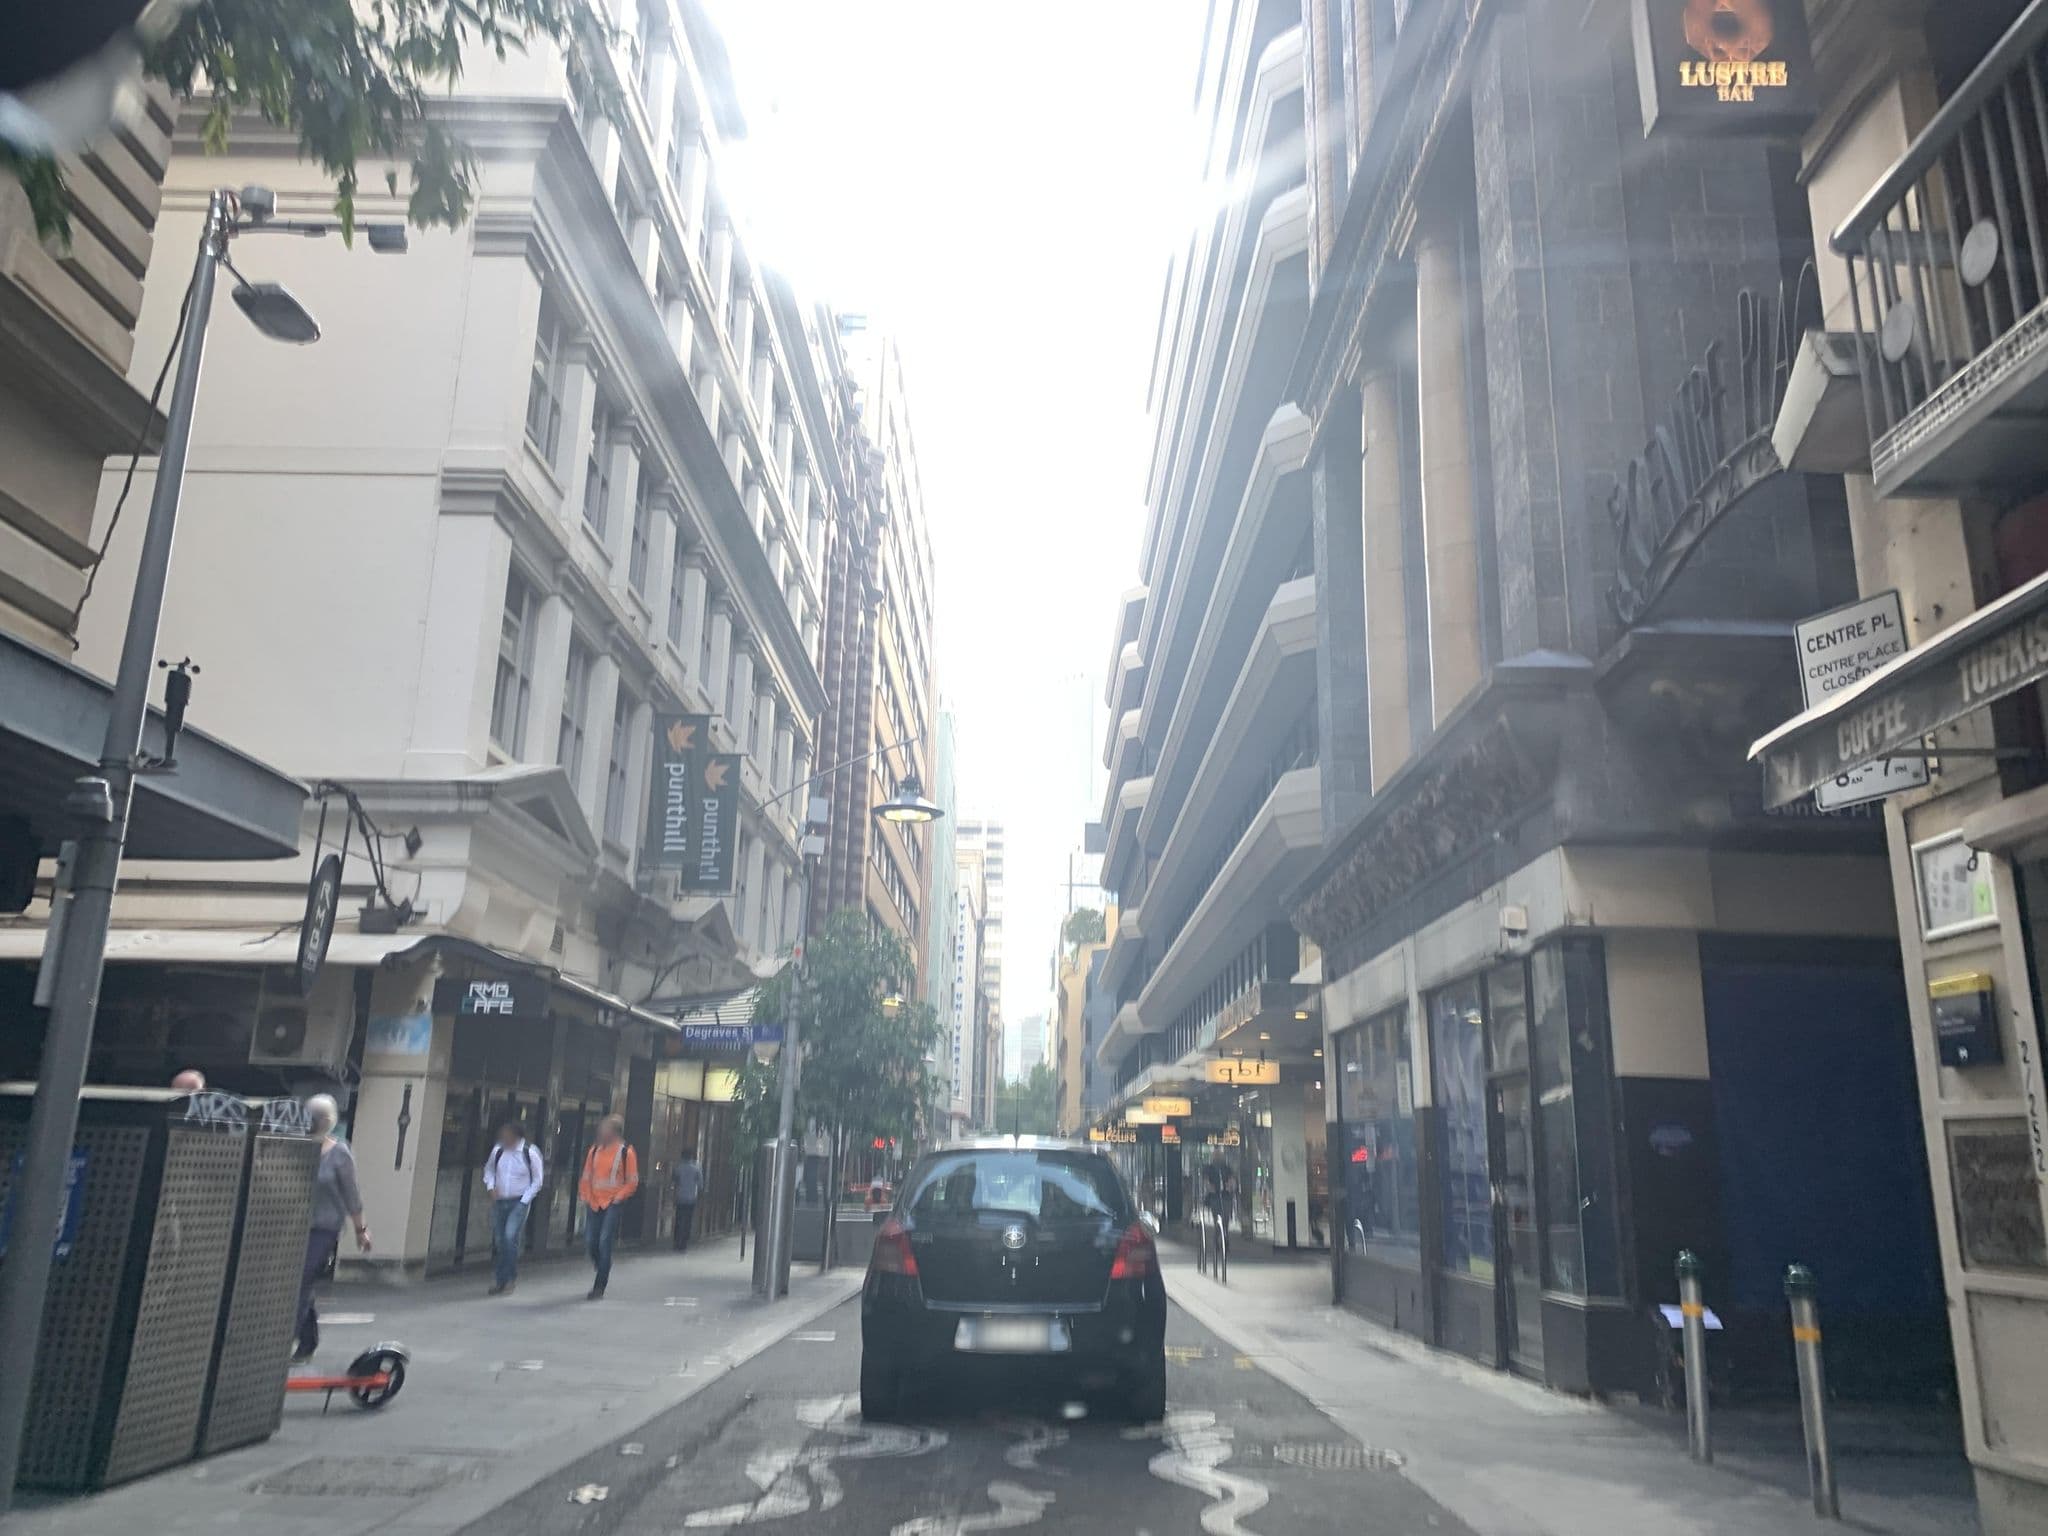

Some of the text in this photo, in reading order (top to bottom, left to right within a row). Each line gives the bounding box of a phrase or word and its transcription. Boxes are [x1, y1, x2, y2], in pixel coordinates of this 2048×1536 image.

[1679, 61, 1788, 86] LUSTRE
[1717, 85, 1754, 101] BAR
[1806, 613, 1894, 653] CENTRE PL
[1808, 654, 1856, 679] CENTRE
[1857, 641, 1900, 663] PLACE
[1837, 698, 1908, 761] COFFEE
[663, 762, 687, 852] punthill
[698, 798, 721, 880] punthill
[956, 903, 966, 984] VICTORIA
[685, 1026, 738, 1041] Degraves
